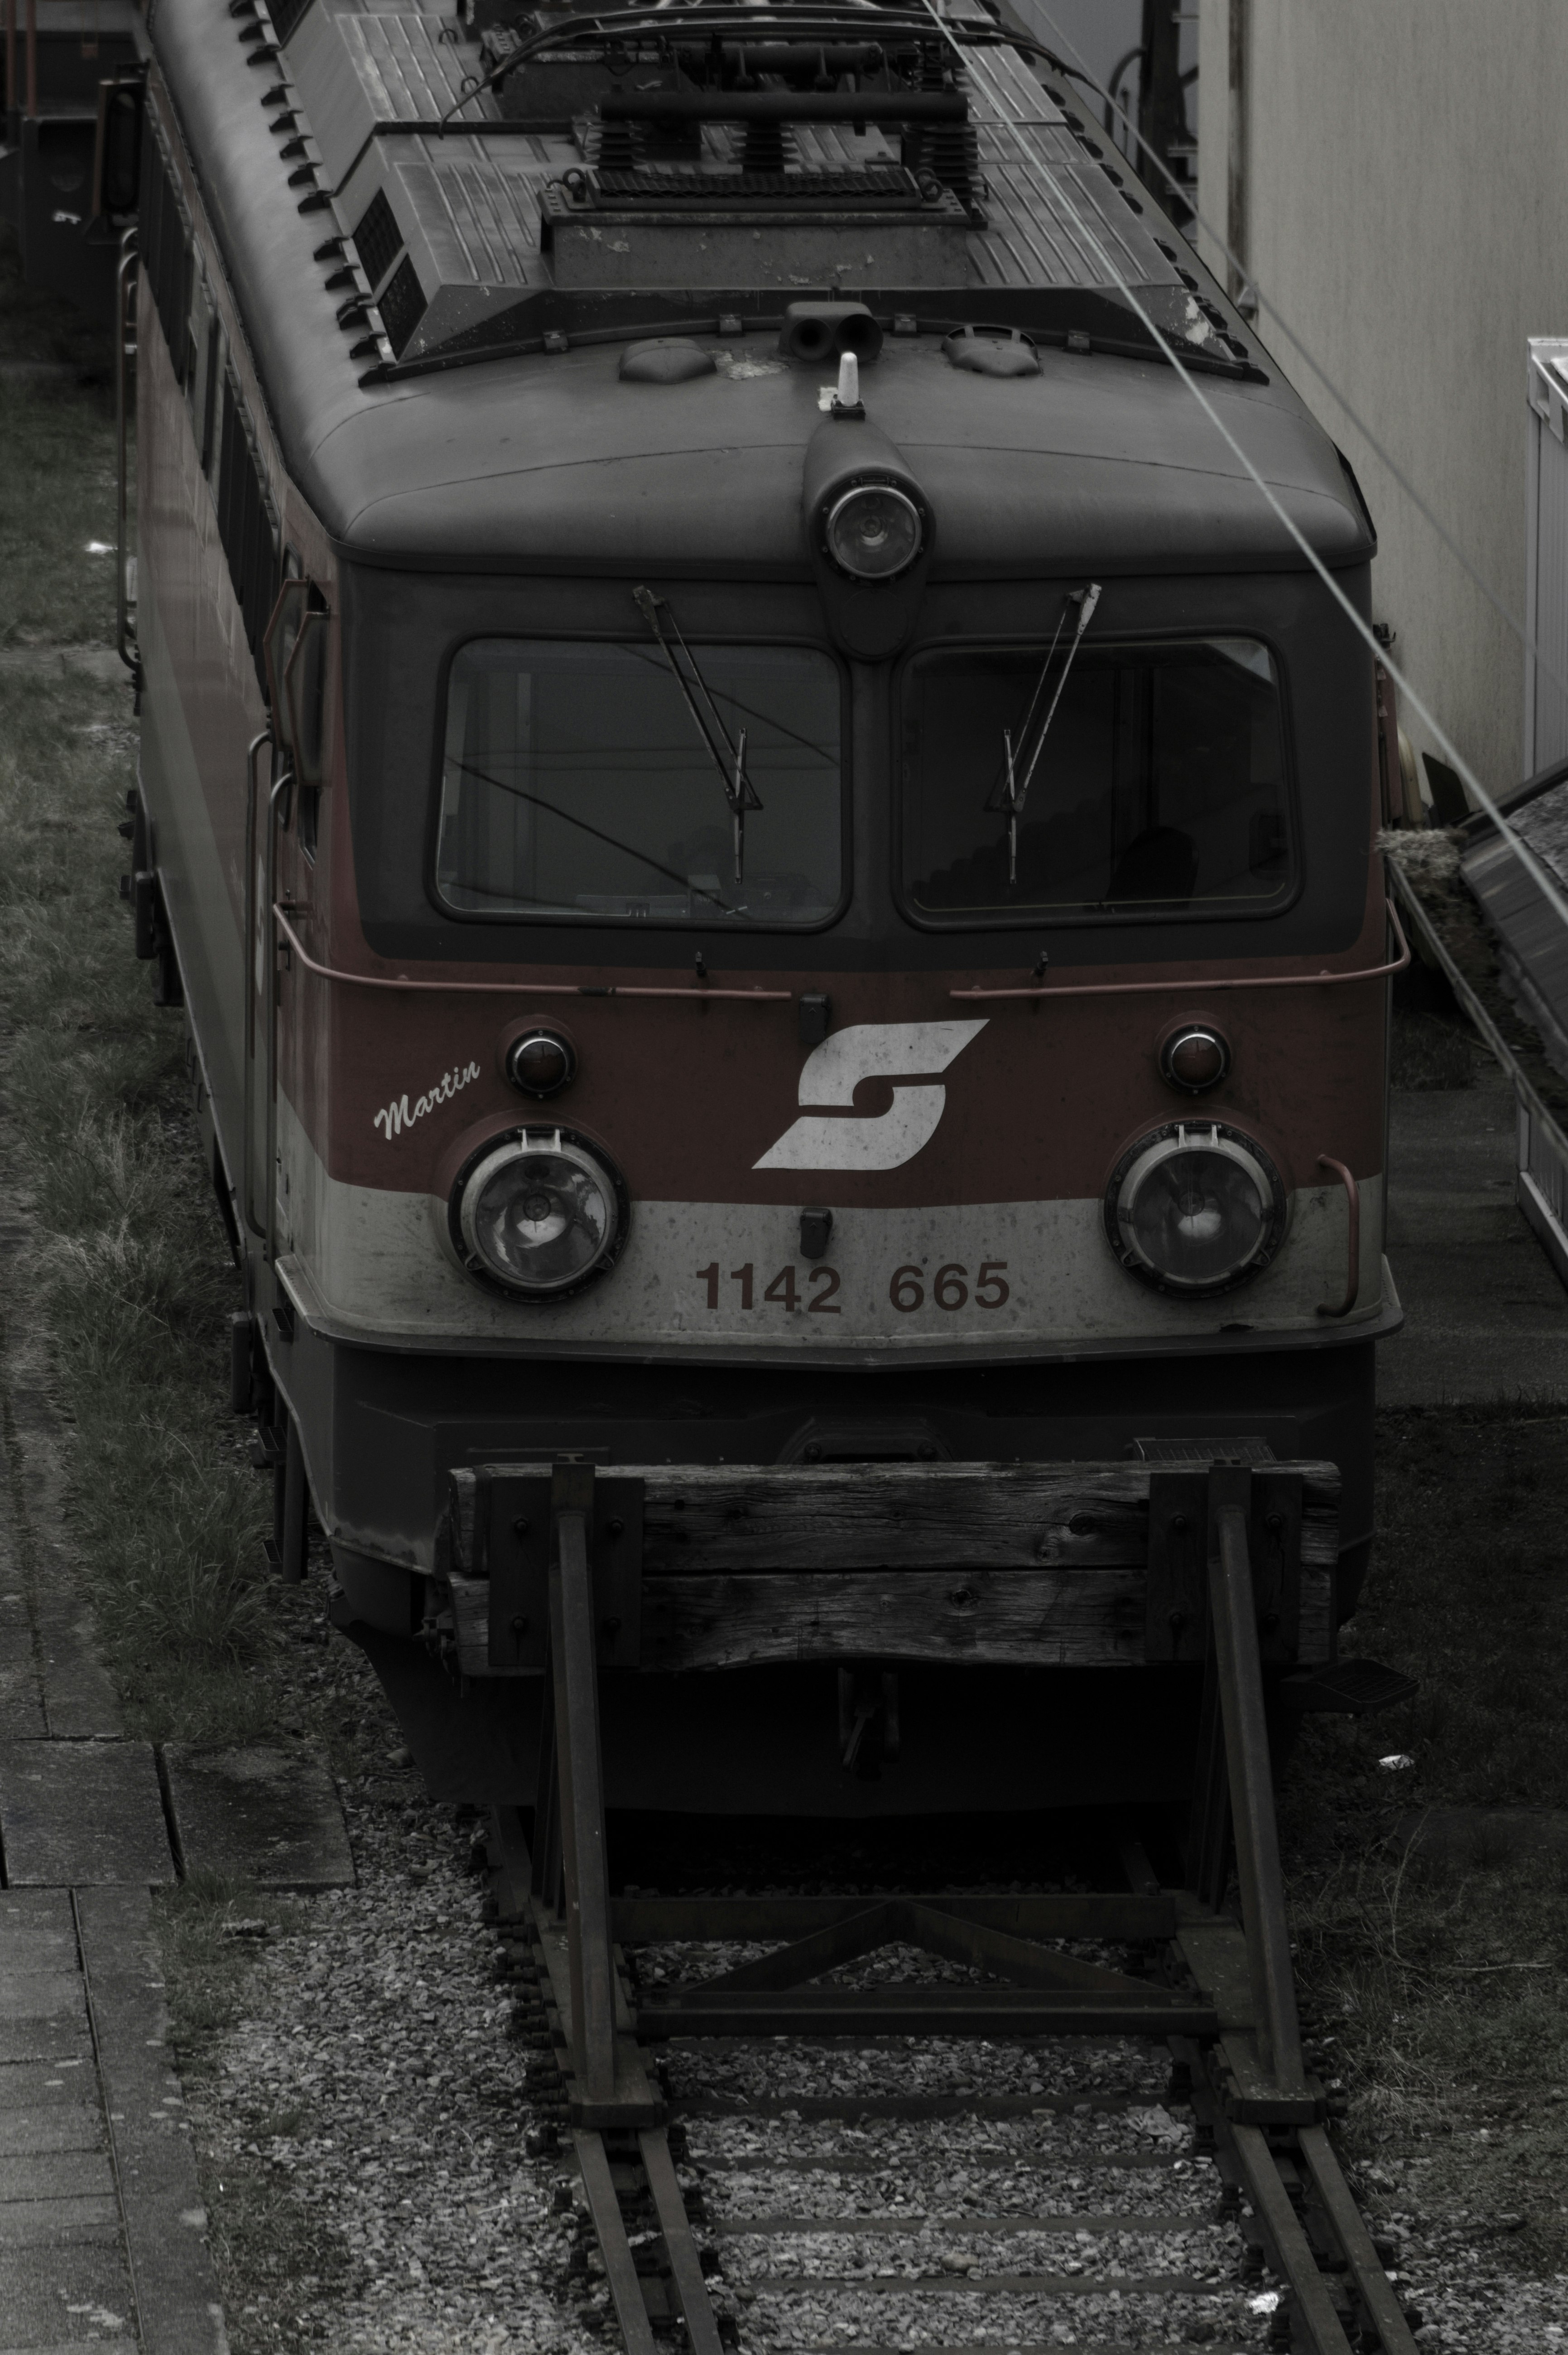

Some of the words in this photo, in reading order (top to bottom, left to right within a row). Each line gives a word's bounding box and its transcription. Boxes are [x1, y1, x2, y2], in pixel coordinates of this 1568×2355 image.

[374, 1061, 480, 1140] Martin
[696, 1262, 842, 1313] 1142
[889, 1262, 1010, 1313] 665
